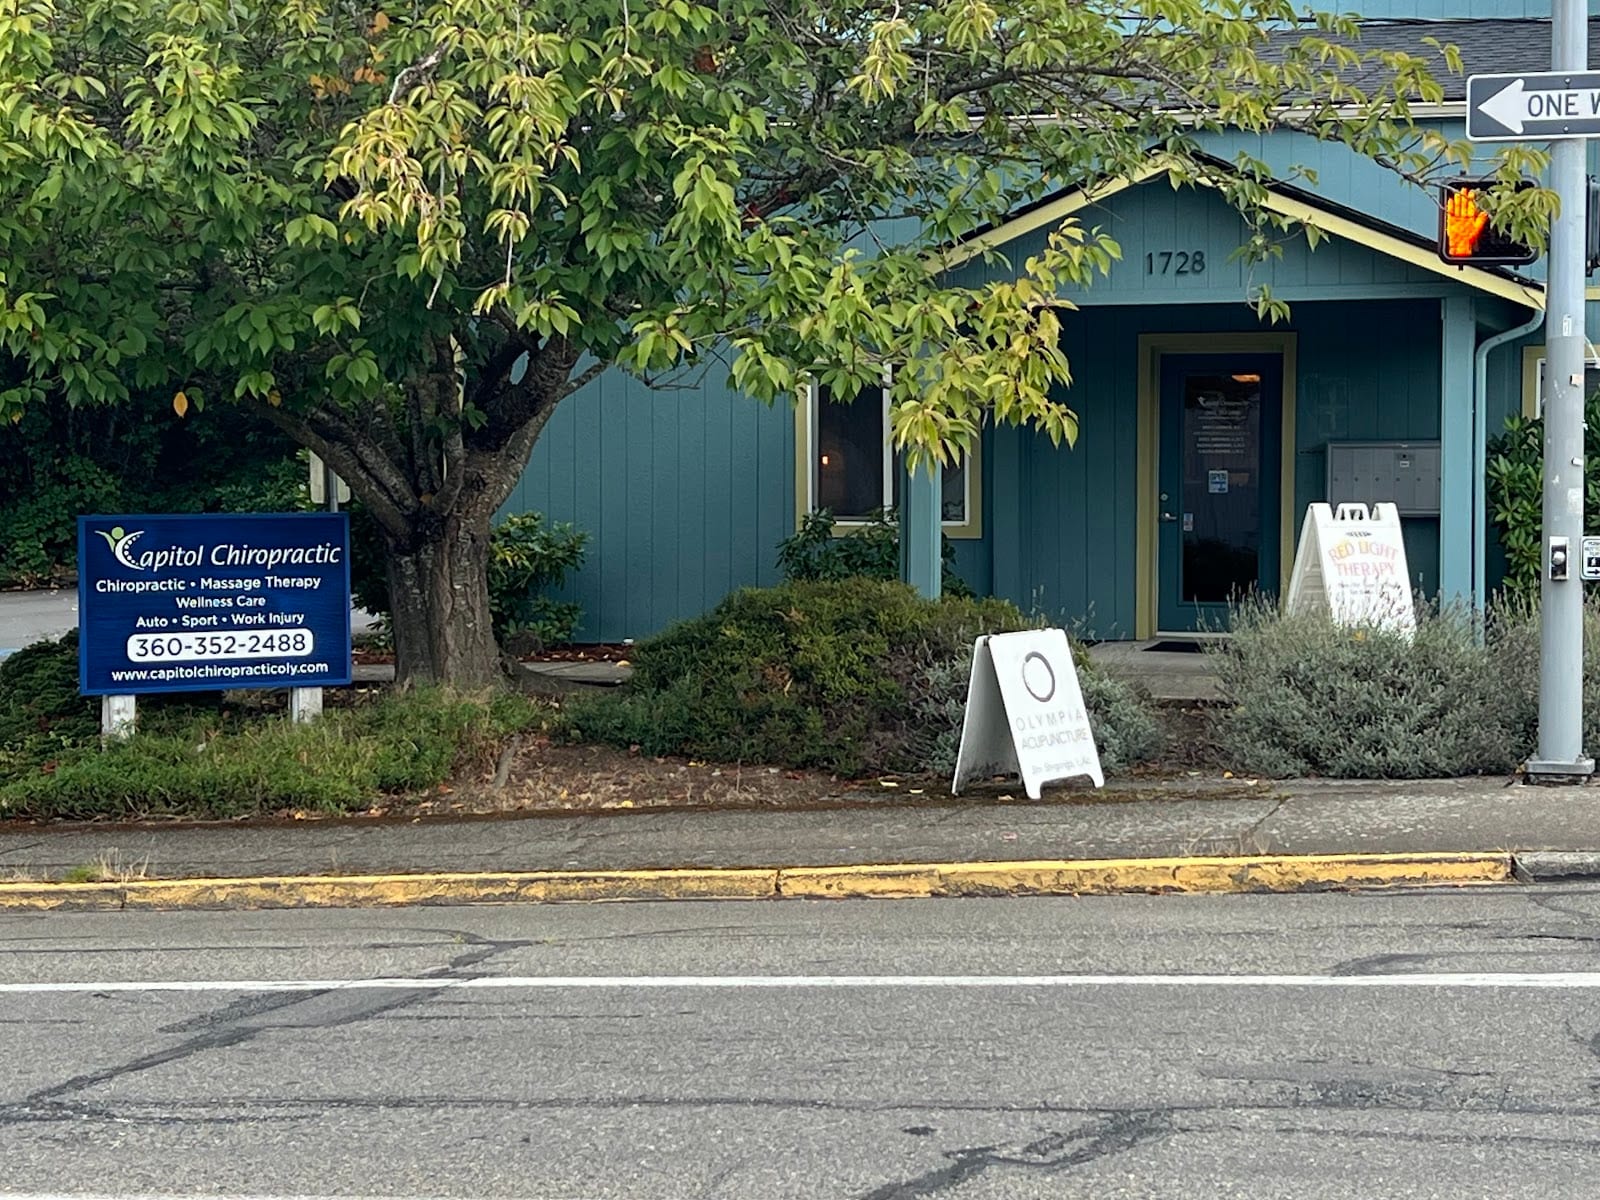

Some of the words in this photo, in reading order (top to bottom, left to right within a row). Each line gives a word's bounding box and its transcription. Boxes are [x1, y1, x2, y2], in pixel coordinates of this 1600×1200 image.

[1528, 93, 1579, 117] ONE
[1147, 251, 1205, 275] 1728
[114, 530, 204, 572] Capitol
[211, 542, 341, 570] Chiropractic
[1328, 540, 1355, 561] RED
[1358, 541, 1399, 560] LIGHT
[1335, 562, 1395, 576] THERAPY
[96, 578, 186, 593] Chiropractic
[200, 578, 261, 592] Massage
[265, 575, 321, 590] Therapy
[176, 597, 233, 609] Wellness
[236, 596, 266, 607] Care
[136, 616, 168, 627] Auto
[181, 615, 218, 628] Sport
[231, 613, 265, 625] Work
[269, 612, 304, 625] Injury
[135, 633, 306, 658] 360-352-2488
[111, 662, 329, 682] www.capitolchiropracticoly.com
[1016, 709, 1083, 731] OLYMPIA
[1022, 728, 1089, 750] ACUPUNCTURE
